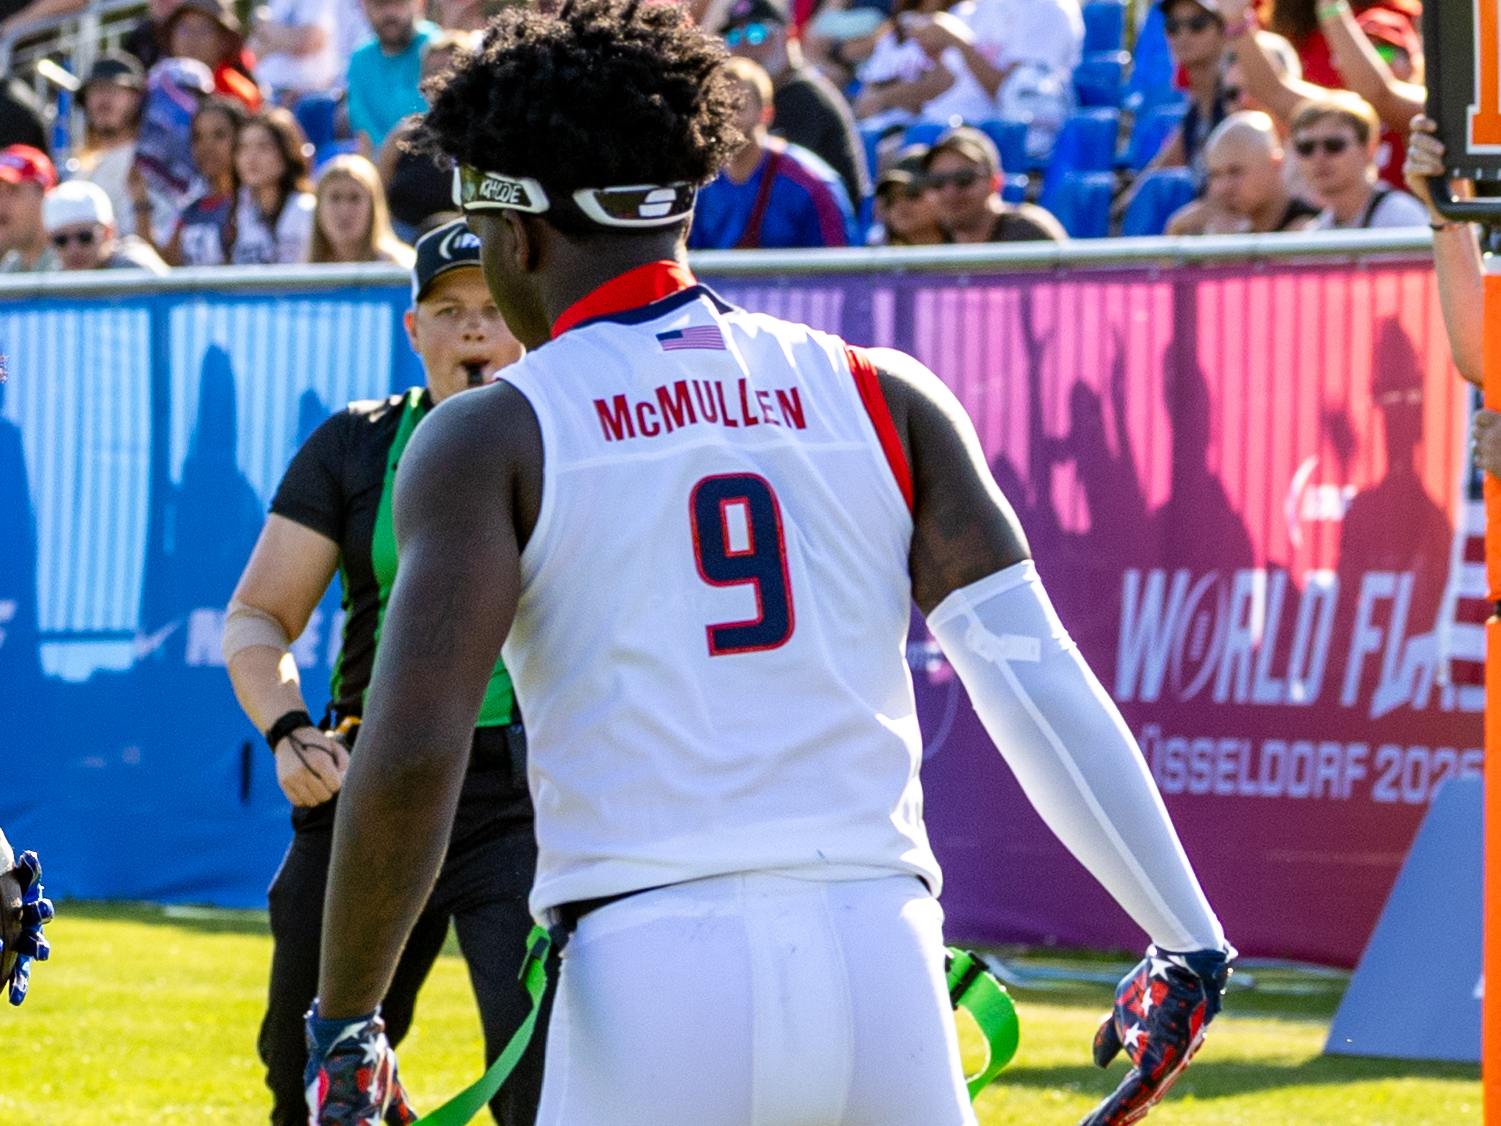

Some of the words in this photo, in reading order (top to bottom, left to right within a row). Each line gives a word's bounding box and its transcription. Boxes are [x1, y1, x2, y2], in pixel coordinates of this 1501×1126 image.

[593, 377, 807, 442] McMULLEN
[688, 471, 796, 657] 9
[1114, 568, 1341, 706] WORLD
[1137, 724, 1372, 801] ÜSSELDORF
